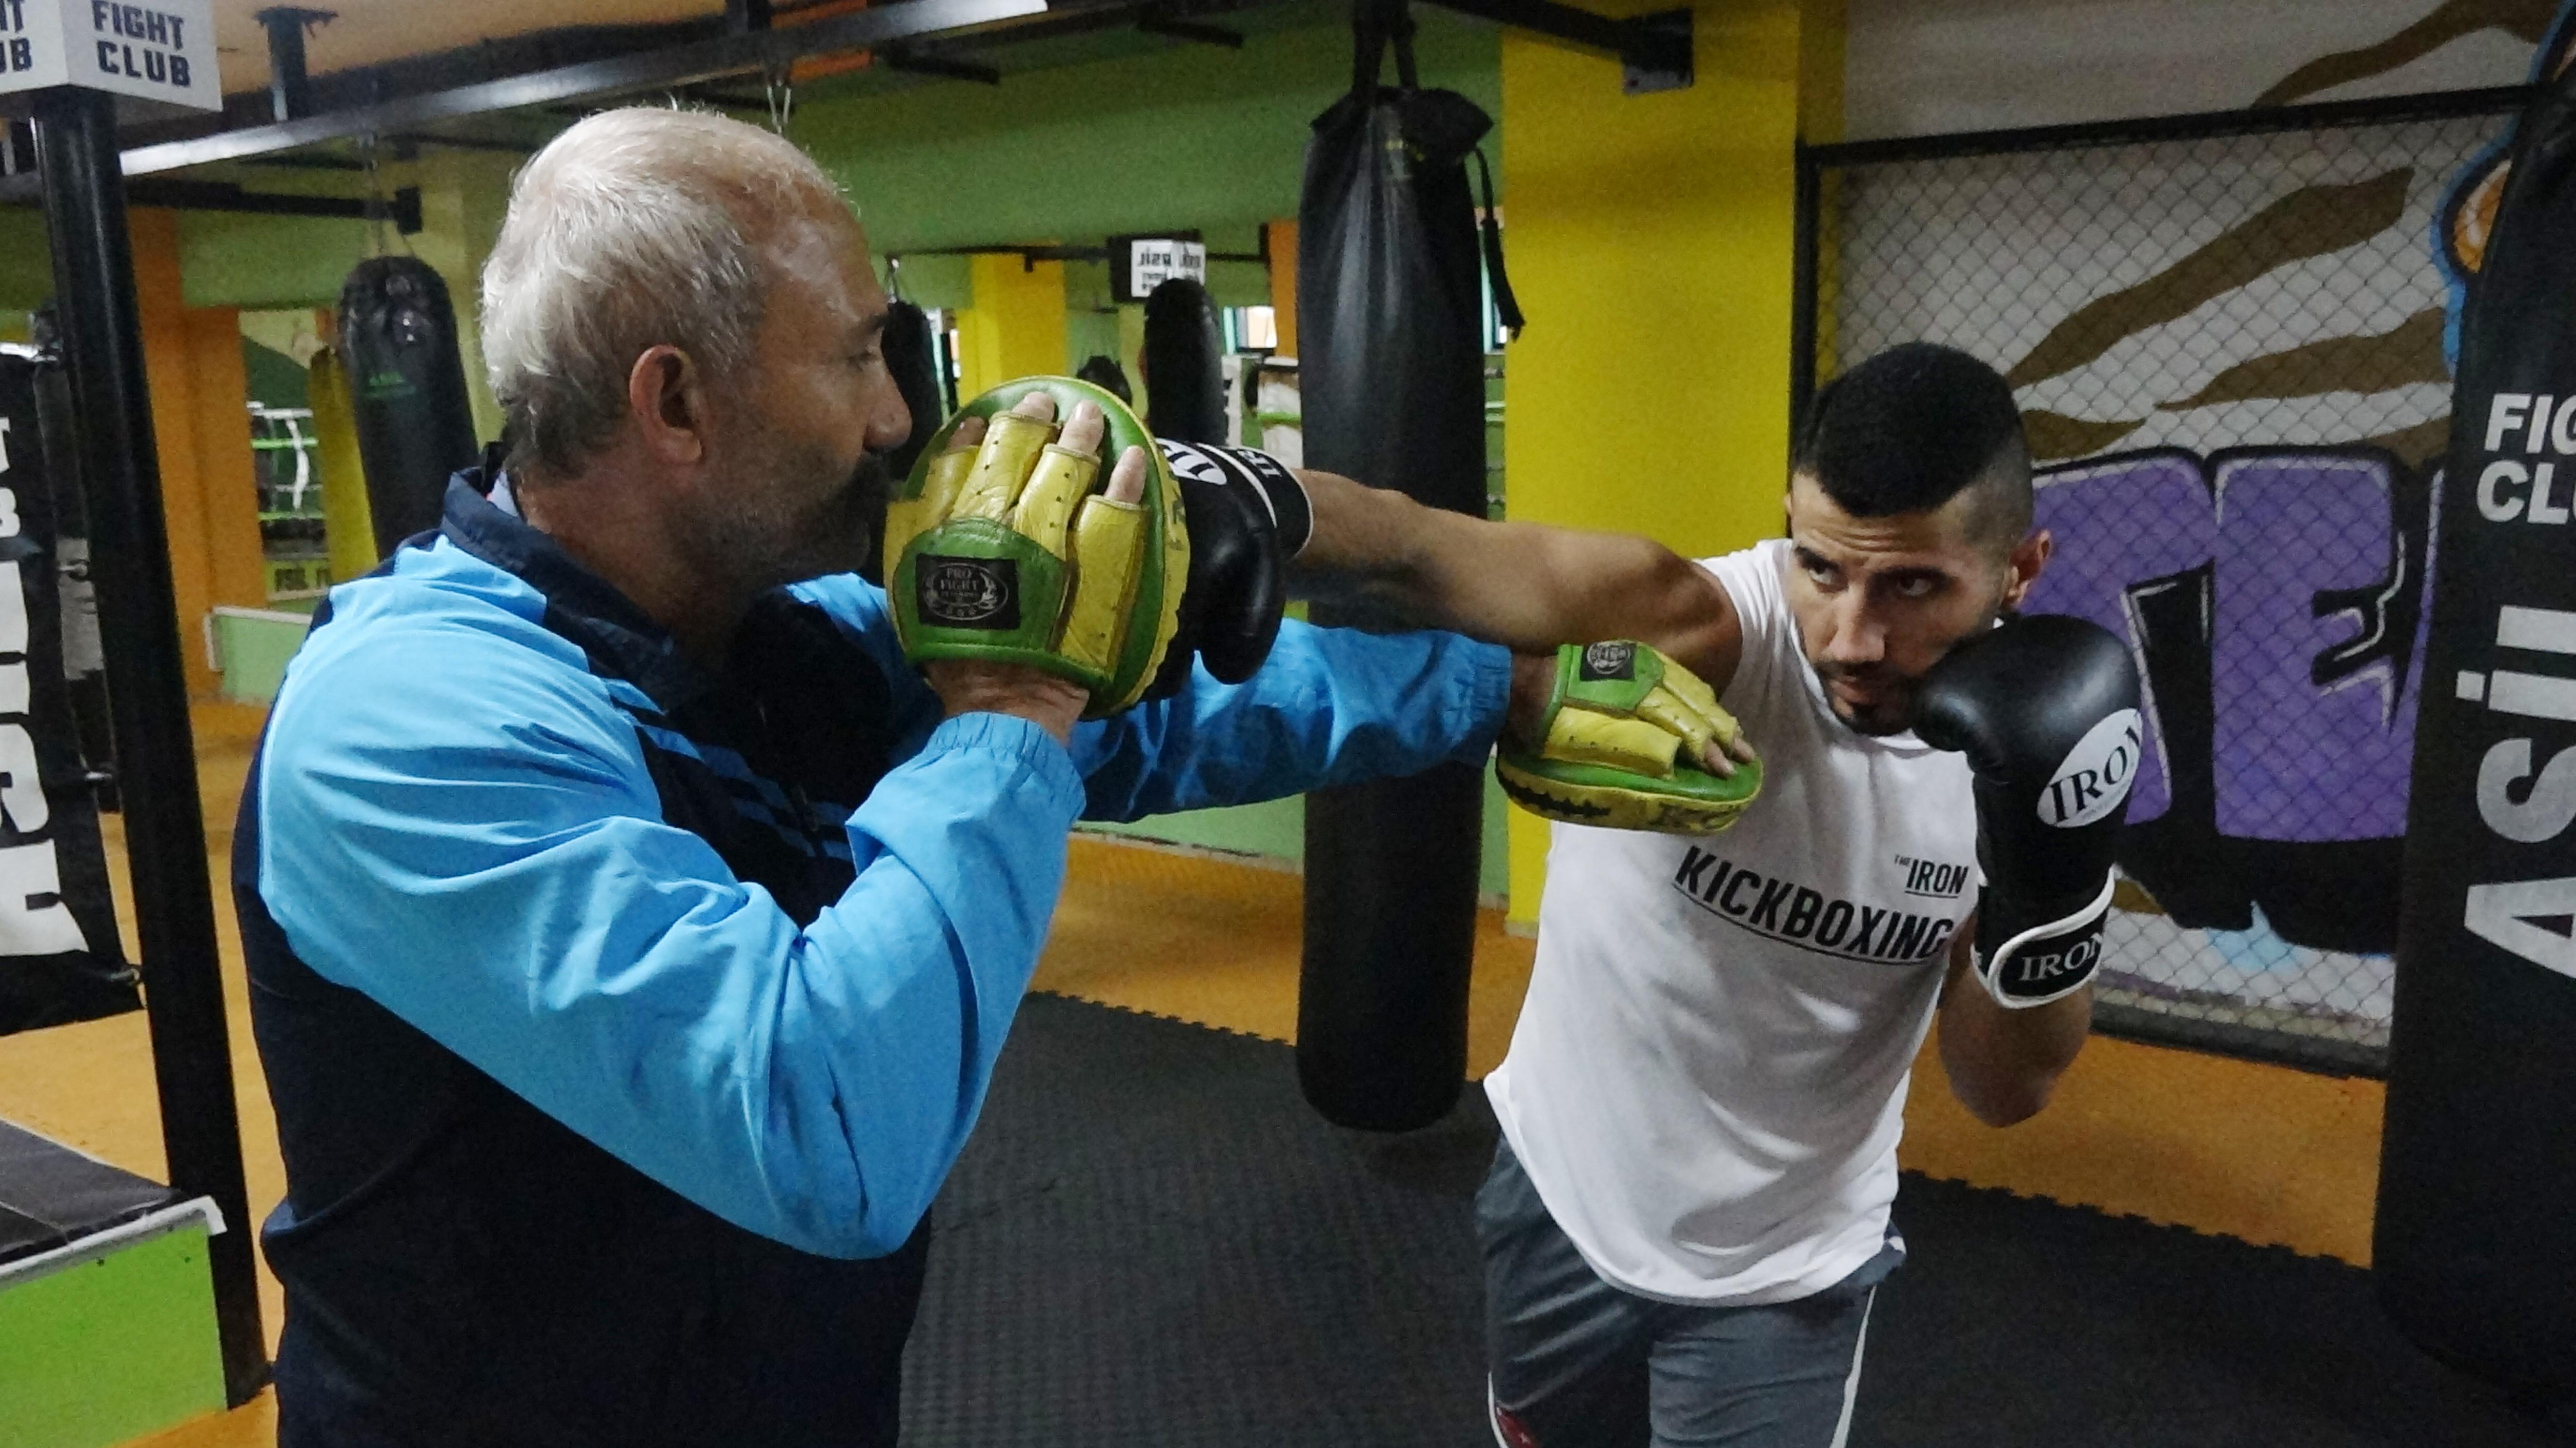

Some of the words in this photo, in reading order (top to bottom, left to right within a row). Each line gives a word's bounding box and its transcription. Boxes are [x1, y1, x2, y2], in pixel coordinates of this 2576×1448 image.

[91, 0, 185, 50] FIGHT
[97, 40, 191, 87] CLUB
[2477, 460, 2576, 524] CL
[1906, 859, 1969, 894] IRON
[1675, 846, 1953, 959] KICKBOXING
